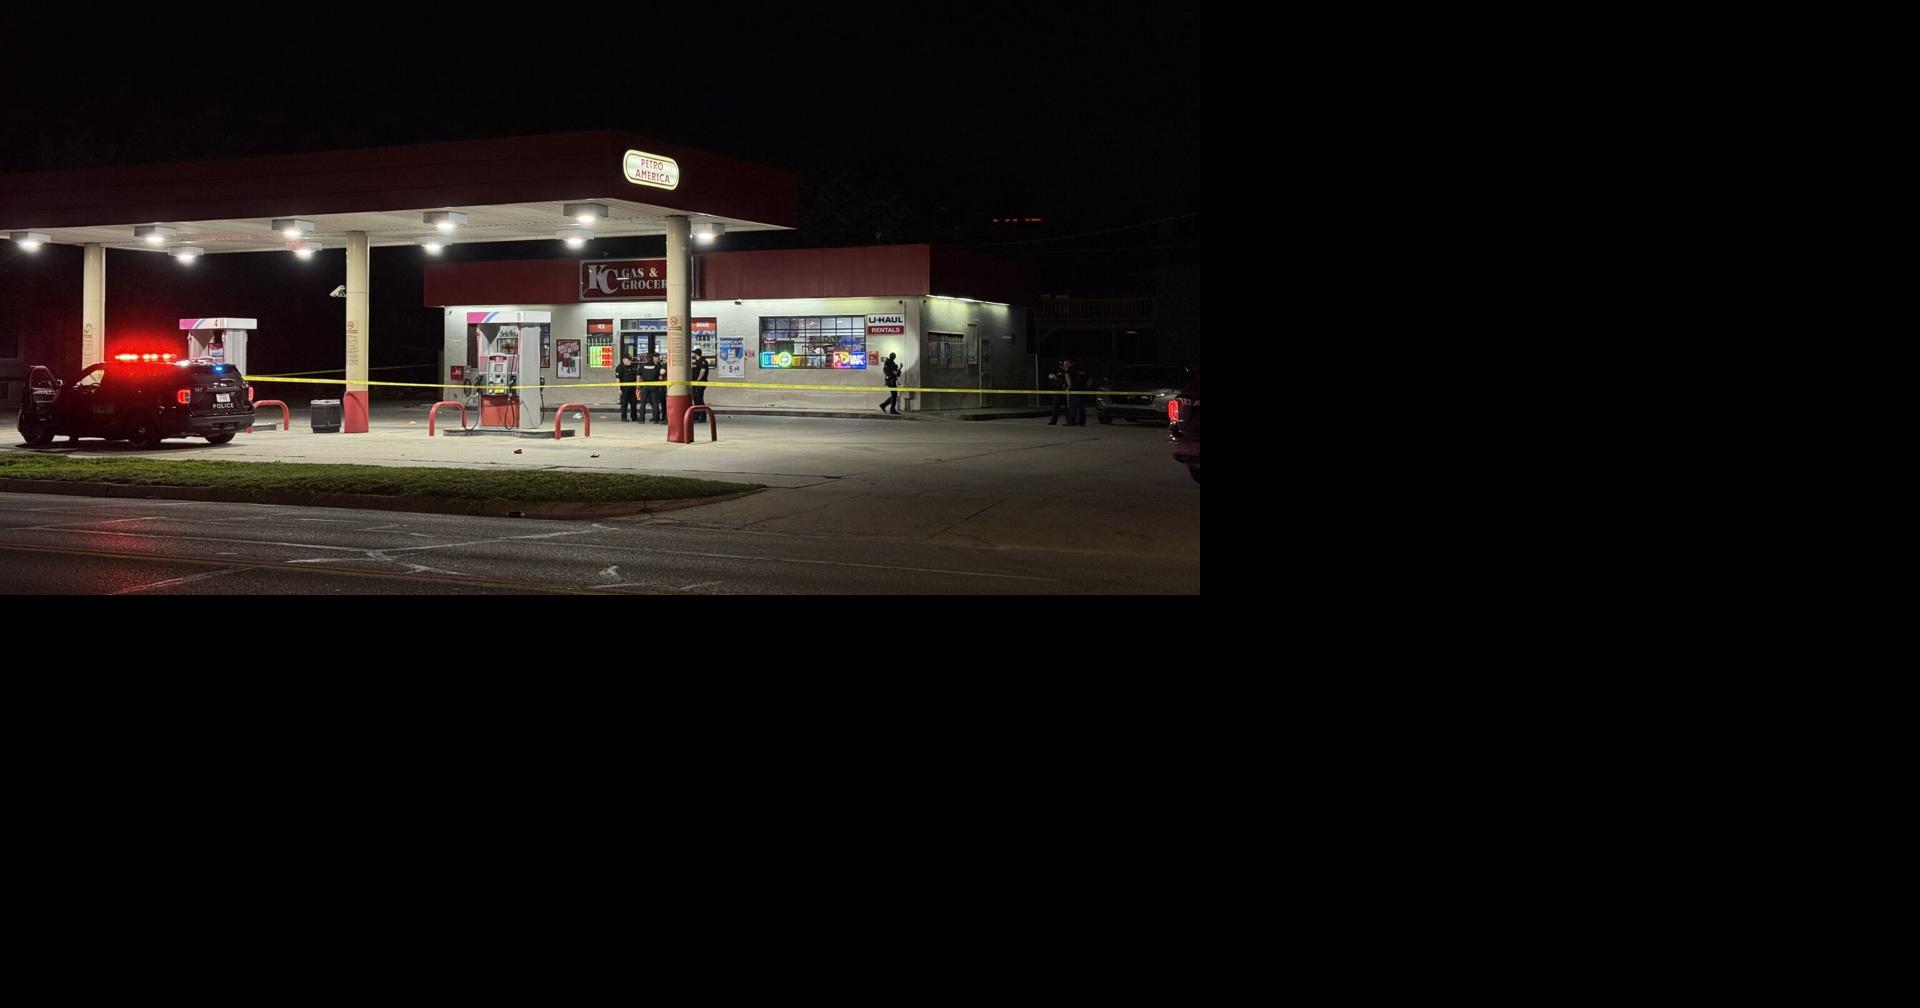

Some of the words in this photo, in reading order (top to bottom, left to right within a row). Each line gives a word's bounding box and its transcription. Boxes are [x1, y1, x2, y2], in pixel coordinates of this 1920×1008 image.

[640, 159, 664, 171] PETRO
[635, 169, 671, 183] AMERICA
[621, 267, 645, 278] GAS
[649, 267, 658, 278] &
[587, 264, 619, 294] KC
[868, 316, 903, 324] U-HAUL
